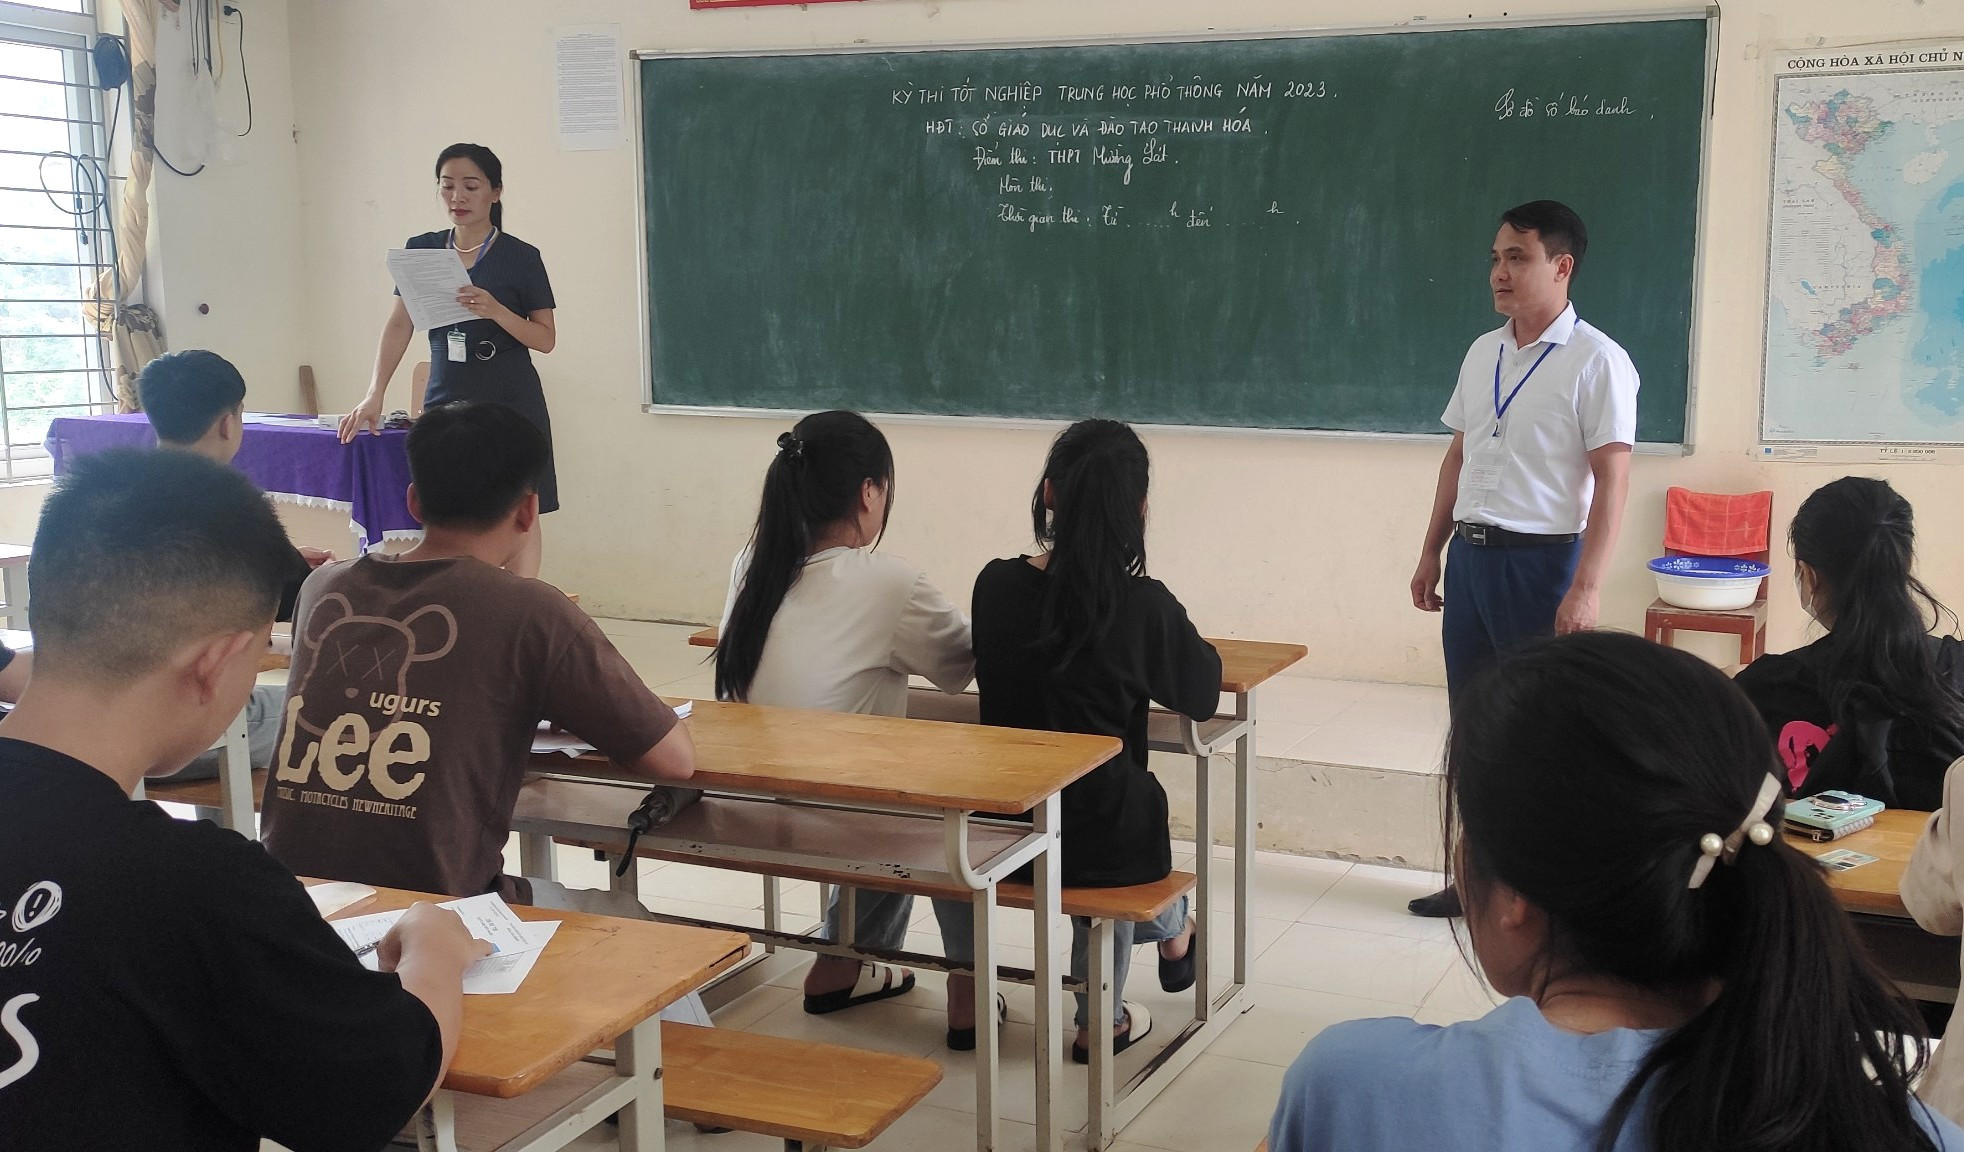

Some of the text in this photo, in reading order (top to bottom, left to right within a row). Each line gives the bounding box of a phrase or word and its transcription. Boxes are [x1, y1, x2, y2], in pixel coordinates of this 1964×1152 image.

[1787, 56, 1825, 71] CỘNG
[1829, 54, 1860, 68] HÒA
[1864, 53, 1884, 66] XÃ
[1889, 52, 1915, 66] HỘI
[1918, 48, 1948, 63] CHỦ
[892, 82, 913, 104] KỲ
[950, 77, 977, 102] TỐT
[1058, 85, 1104, 102] TRUNG
[1112, 86, 1137, 107] HỌC
[1144, 75, 1174, 99] PHỔ
[1176, 75, 1224, 100] THÔNG
[1236, 74, 1272, 98] NĂM
[1072, 118, 1089, 137] VÀ
[1163, 118, 1213, 133] THANH
[1048, 149, 1081, 165] THPT
[369, 691, 442, 717] ugurs
[276, 695, 431, 800] Lee
